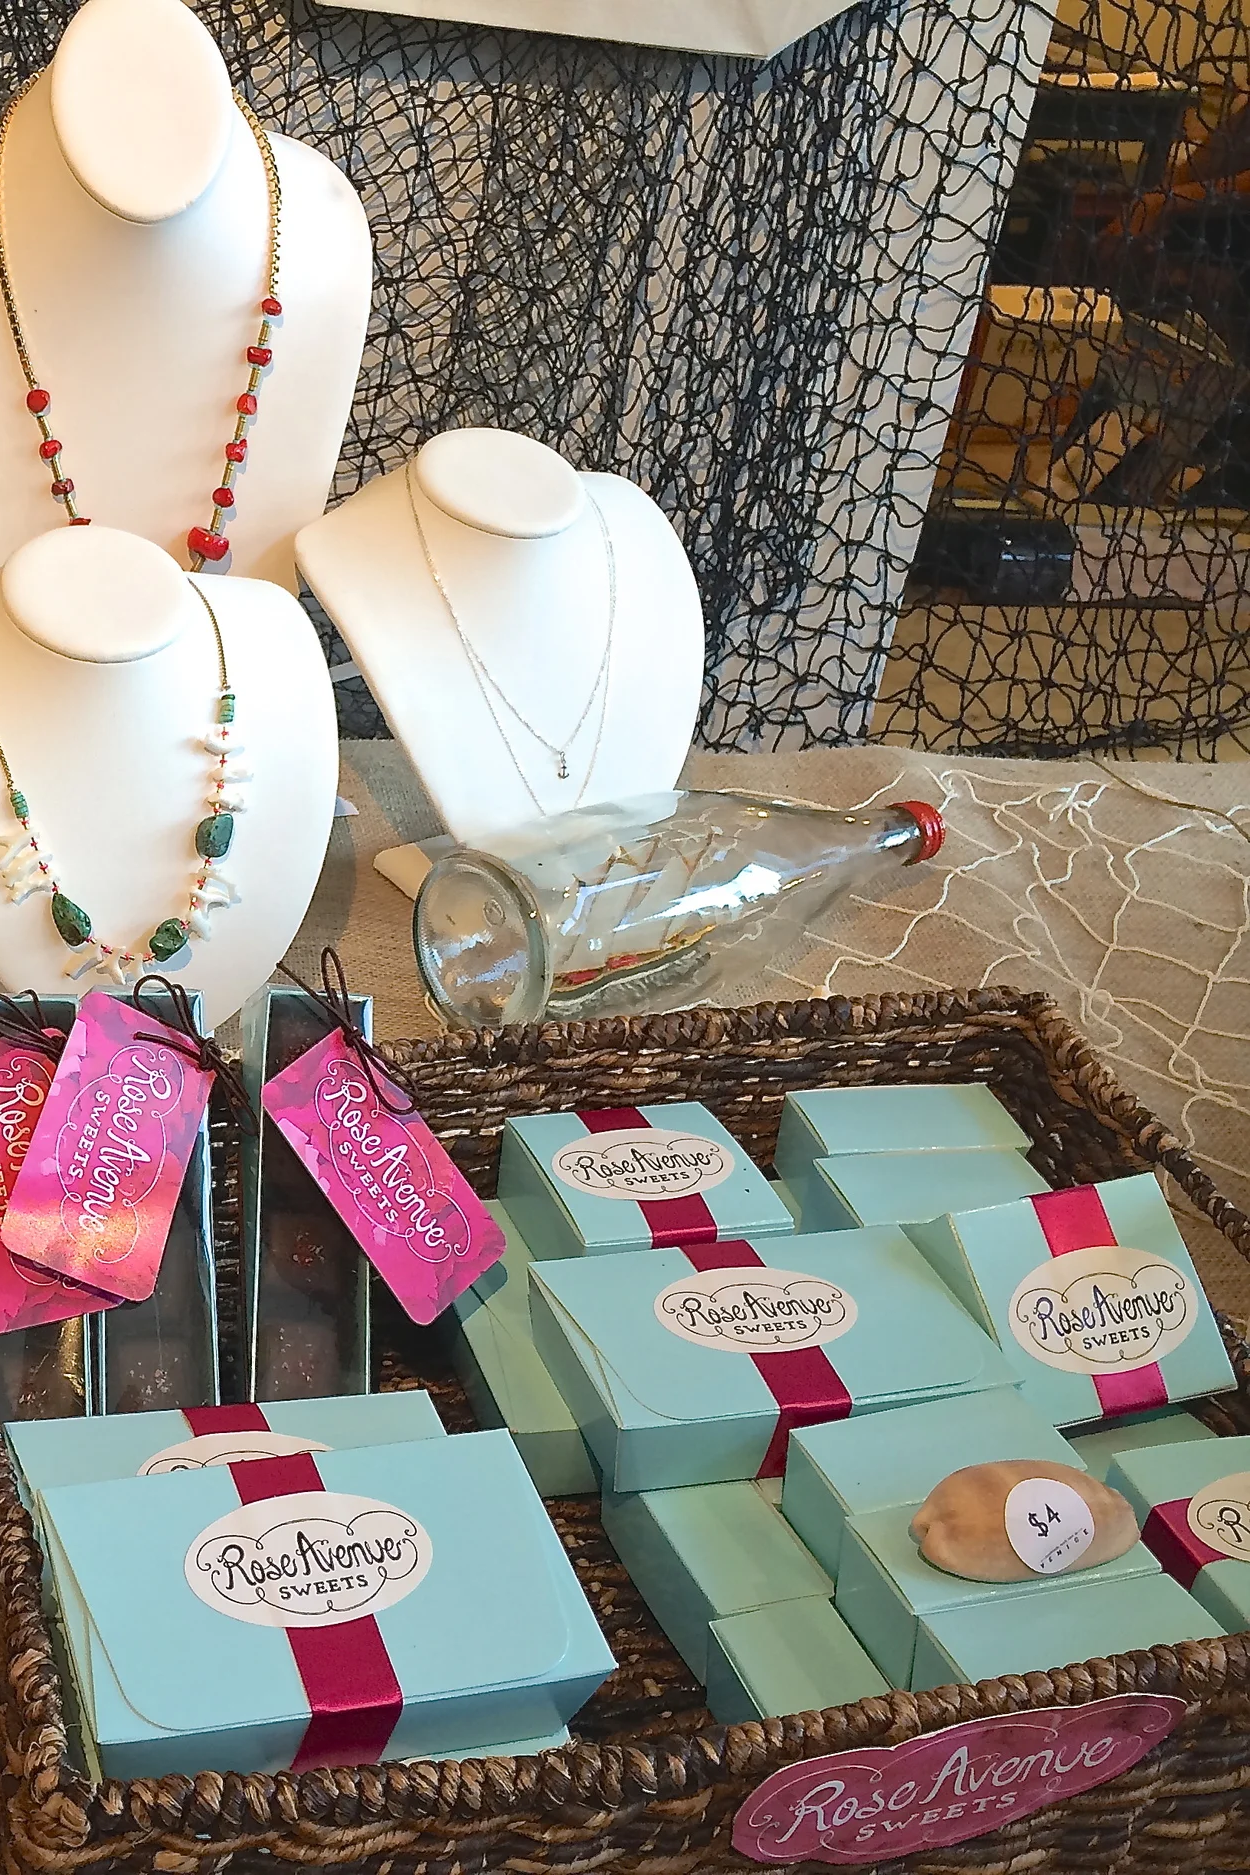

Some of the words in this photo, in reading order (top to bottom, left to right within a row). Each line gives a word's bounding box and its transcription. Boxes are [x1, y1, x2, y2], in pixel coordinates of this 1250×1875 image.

[112, 1054, 172, 1133] Rose
[69, 1090, 111, 1179] SWEETS
[79, 1130, 151, 1235] Avenue
[323, 1077, 380, 1154] Rose
[371, 1144, 446, 1247] Avenue
[338, 1140, 400, 1223] SWEETS
[575, 1155, 636, 1181] Rose
[632, 1147, 712, 1173] Avenue
[624, 1171, 690, 1186] SWEETS
[680, 1297, 747, 1327] Rose
[743, 1290, 833, 1320] Avenue
[733, 1319, 808, 1335] SWEETS
[1033, 1296, 1096, 1340] Rose
[1092, 1284, 1175, 1328] Avenue
[1082, 1325, 1151, 1350] SWEETS
[1028, 1503, 1061, 1537] $4
[217, 1543, 297, 1590] Rose
[296, 1530, 402, 1576] Avenue
[278, 1574, 369, 1600] SWEETS
[775, 1779, 922, 1844] Rose
[919, 1735, 1117, 1806] Avenue
[854, 1790, 1018, 1842] SWEETS
